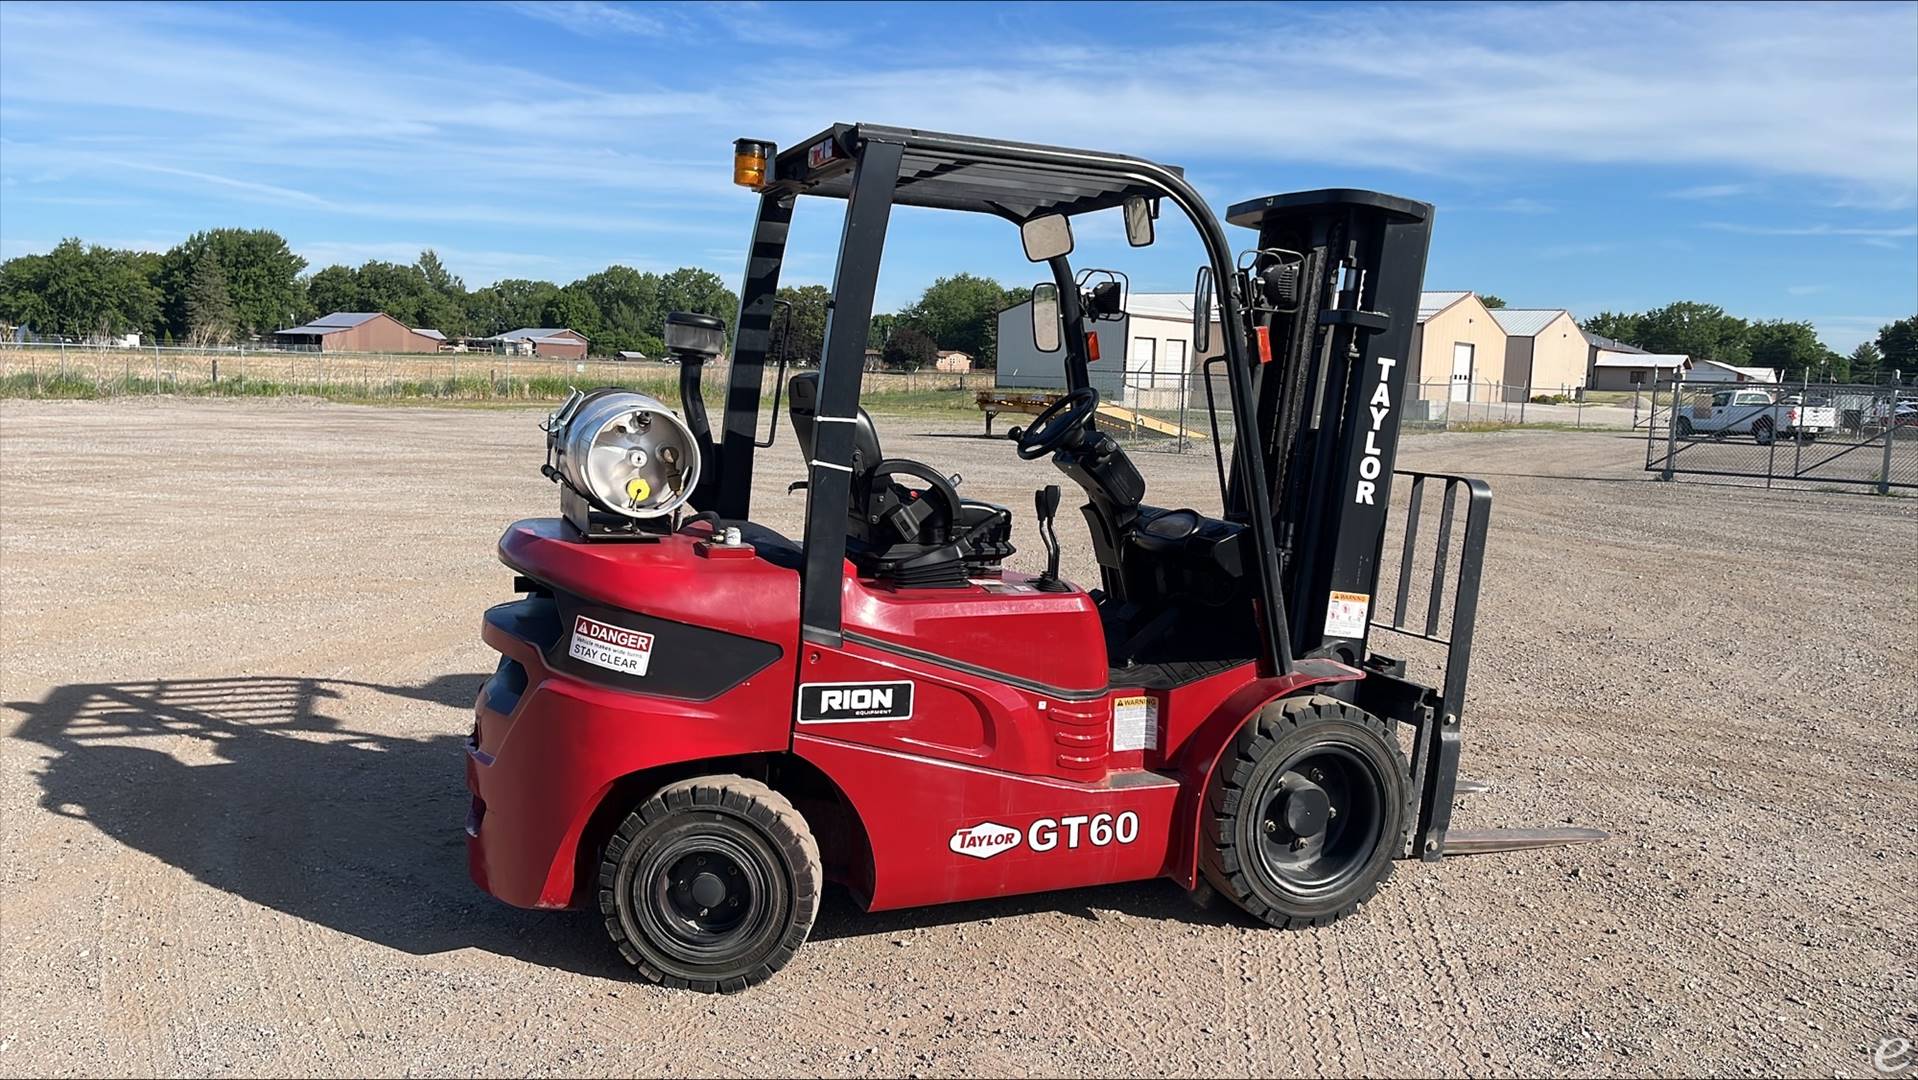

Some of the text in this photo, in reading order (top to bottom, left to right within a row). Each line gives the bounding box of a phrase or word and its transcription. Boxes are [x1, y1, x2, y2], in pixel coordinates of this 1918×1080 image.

[1355, 357, 1396, 505] TAYLOR
[590, 624, 649, 650] DANGER
[594, 642, 611, 652] makes
[574, 644, 637, 669] STAY CLEAR
[820, 688, 893, 714] RION
[1124, 698, 1157, 706] WARNING
[958, 830, 1015, 849] TAYLOR
[1028, 810, 1139, 852] GT60
